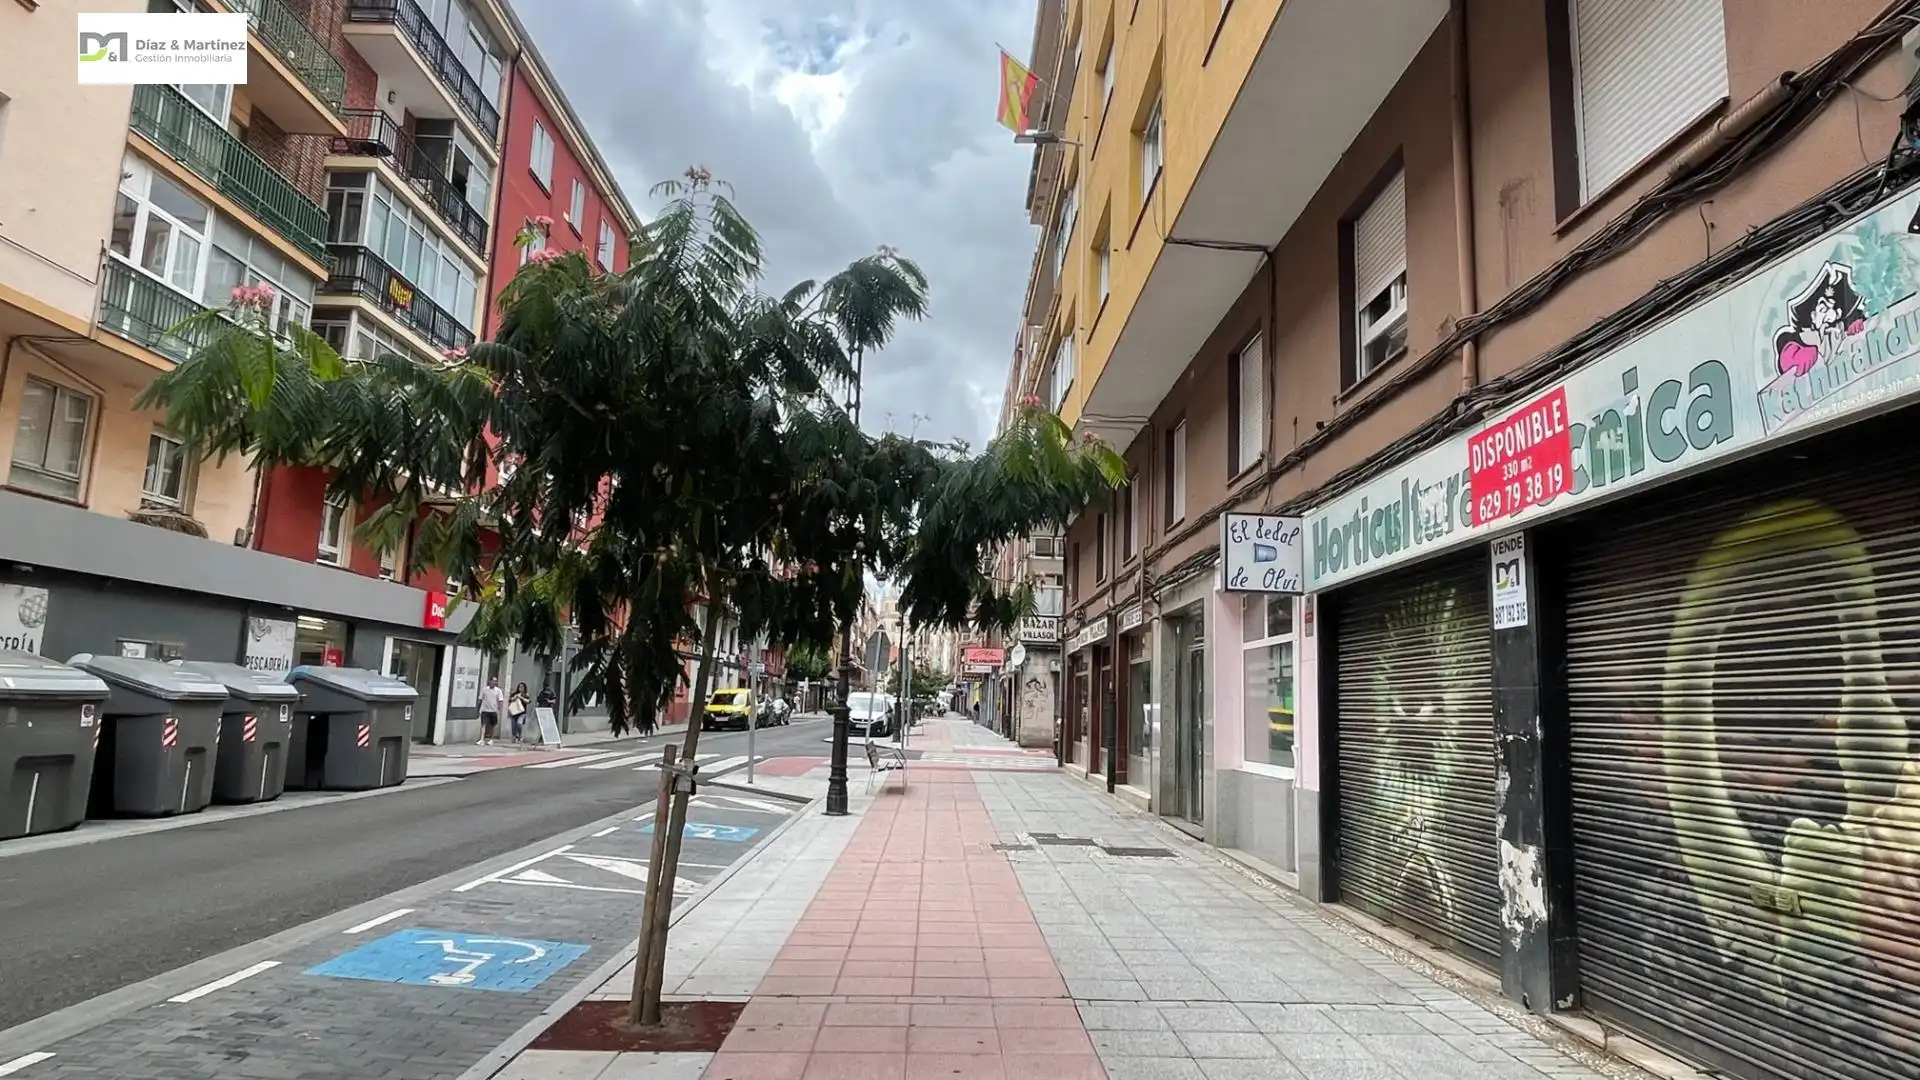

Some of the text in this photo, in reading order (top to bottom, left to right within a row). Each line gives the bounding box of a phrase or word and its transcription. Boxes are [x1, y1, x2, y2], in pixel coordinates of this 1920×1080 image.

[1472, 398, 1565, 475] DISPONIBLE
[1510, 366, 1734, 518] cnica
[1502, 456, 1533, 481] 330 m2
[1479, 463, 1563, 521] 629 79 38 19
[1230, 517, 1300, 546] El dedal
[1492, 536, 1523, 556] VENDE
[1230, 566, 1299, 590] de Olvi
[1023, 618, 1055, 629] BAZAR
[245, 654, 289, 671] PESCADERÍA
